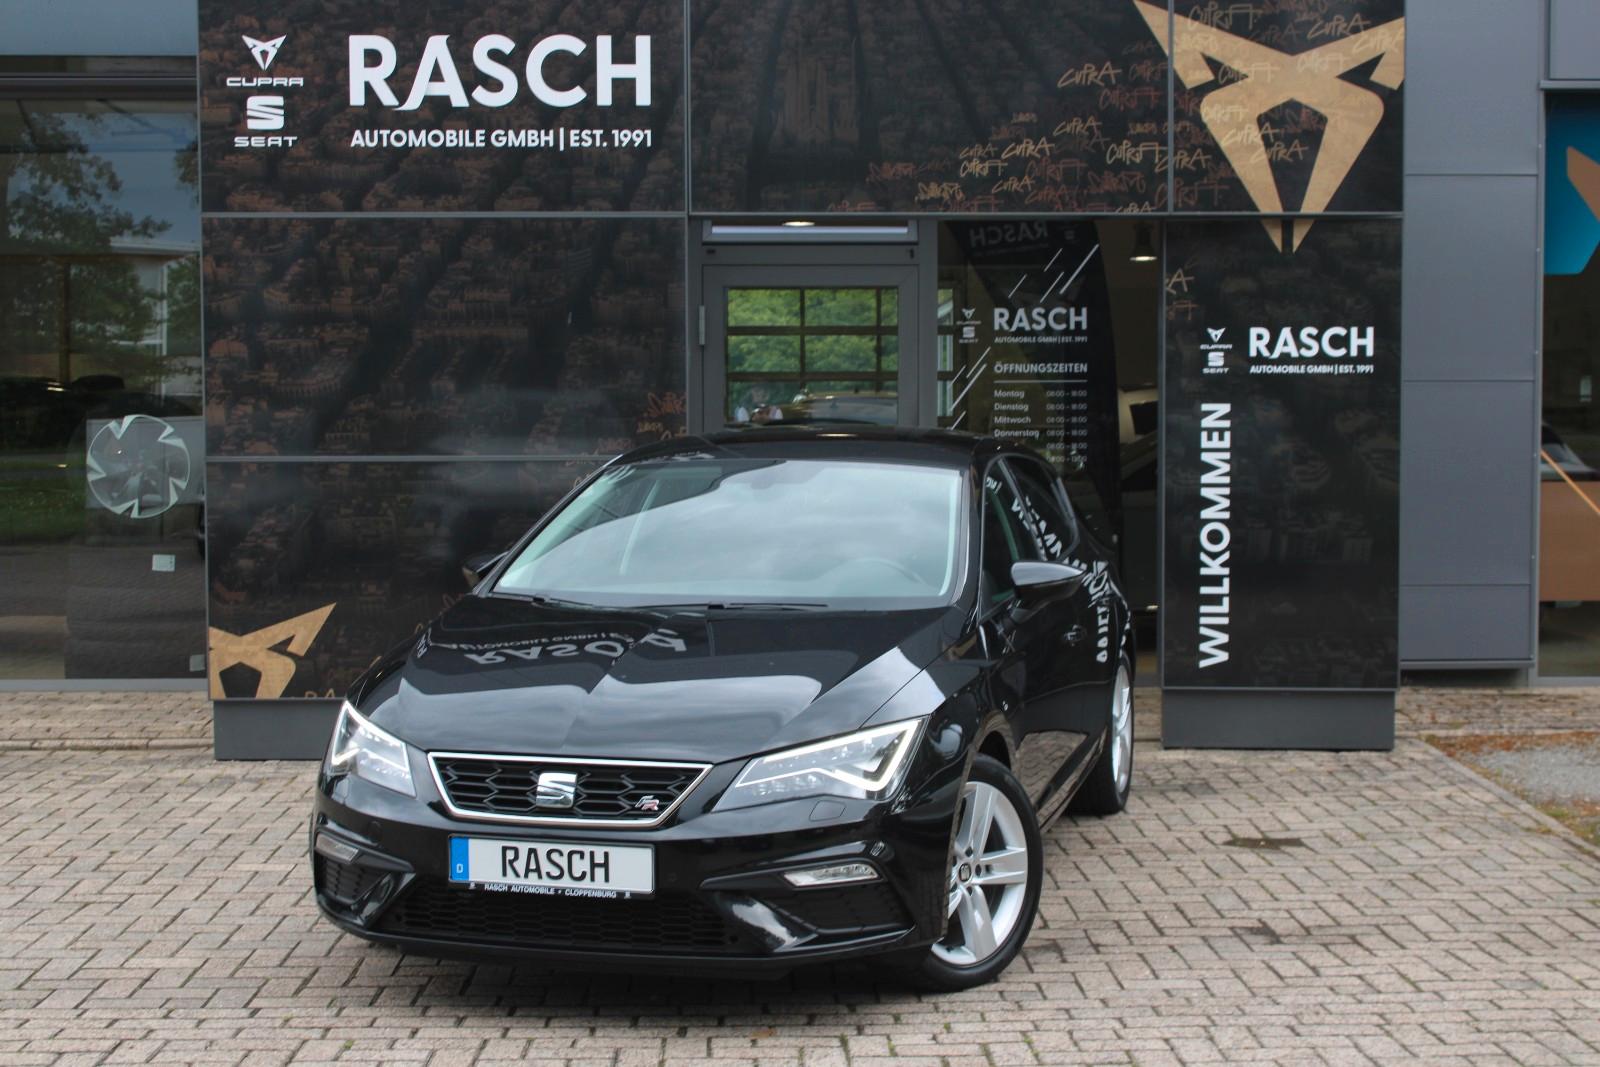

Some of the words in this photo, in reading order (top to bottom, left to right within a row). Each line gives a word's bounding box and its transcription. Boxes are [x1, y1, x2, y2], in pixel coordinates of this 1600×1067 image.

[349, 34, 652, 111] RASCH
[1057, 60, 1122, 88] CUPRA
[226, 77, 304, 87] CUPRA
[234, 136, 297, 148] SEAT
[350, 129, 486, 148] AUTOMOBILE
[491, 129, 554, 148] GMBH
[569, 129, 607, 148] EST.
[611, 129, 652, 148] 1991
[1001, 137, 1055, 159] CUPRA
[993, 306, 1088, 332] RASCH
[994, 336, 1036, 344] AUTOMOBILE
[1249, 326, 1375, 359] RASCH
[993, 361, 1088, 373] ÖFFNUNGSZEITEN
[1250, 364, 1306, 374] AUTOMOBILE
[1307, 364, 1334, 374] GMBH
[1339, 364, 1355, 374] EST.
[1356, 364, 1374, 374] 1991
[994, 389, 1025, 399] Montag
[994, 402, 1029, 412] Dienstag
[994, 416, 1031, 424] Mittwoch
[994, 429, 1040, 440] Donnerstag
[1199, 402, 1231, 669] WILLKOMMEN
[456, 863, 464, 873] D
[501, 845, 610, 883] RASCH
[484, 883, 508, 892] RASCH
[511, 885, 555, 895] AUTOMOBILE
[565, 889, 617, 898] CLOPPENBURG
